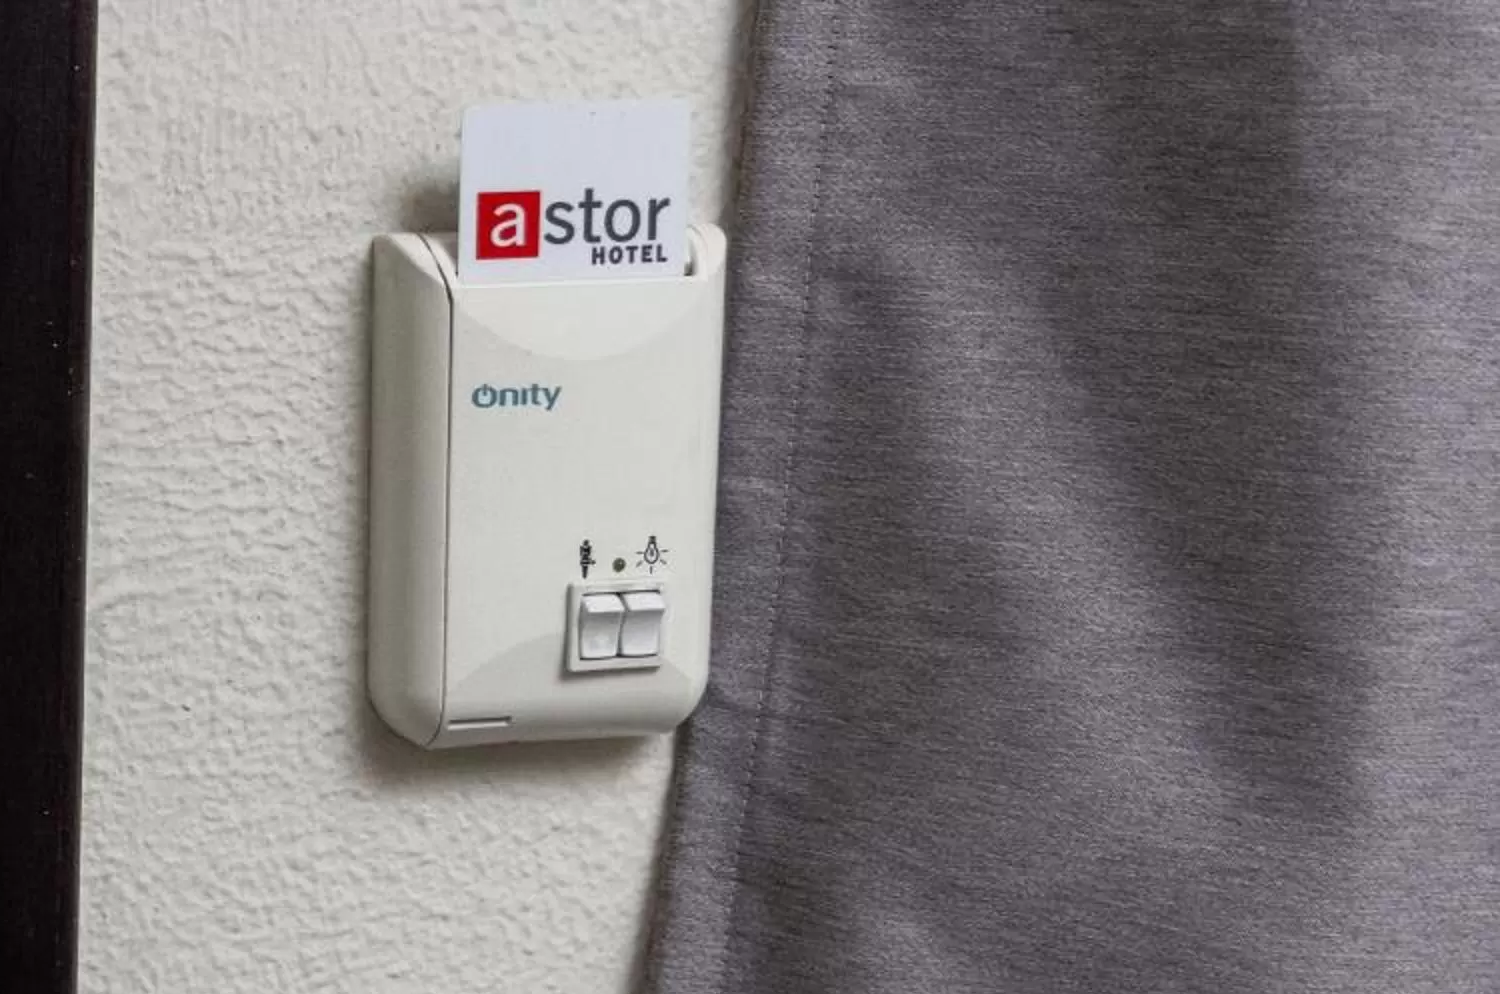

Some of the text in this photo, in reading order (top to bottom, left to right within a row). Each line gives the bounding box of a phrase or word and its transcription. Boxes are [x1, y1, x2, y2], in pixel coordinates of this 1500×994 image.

[488, 187, 671, 247] astor
[591, 244, 668, 265] HOTEL
[471, 383, 562, 411] Onity
